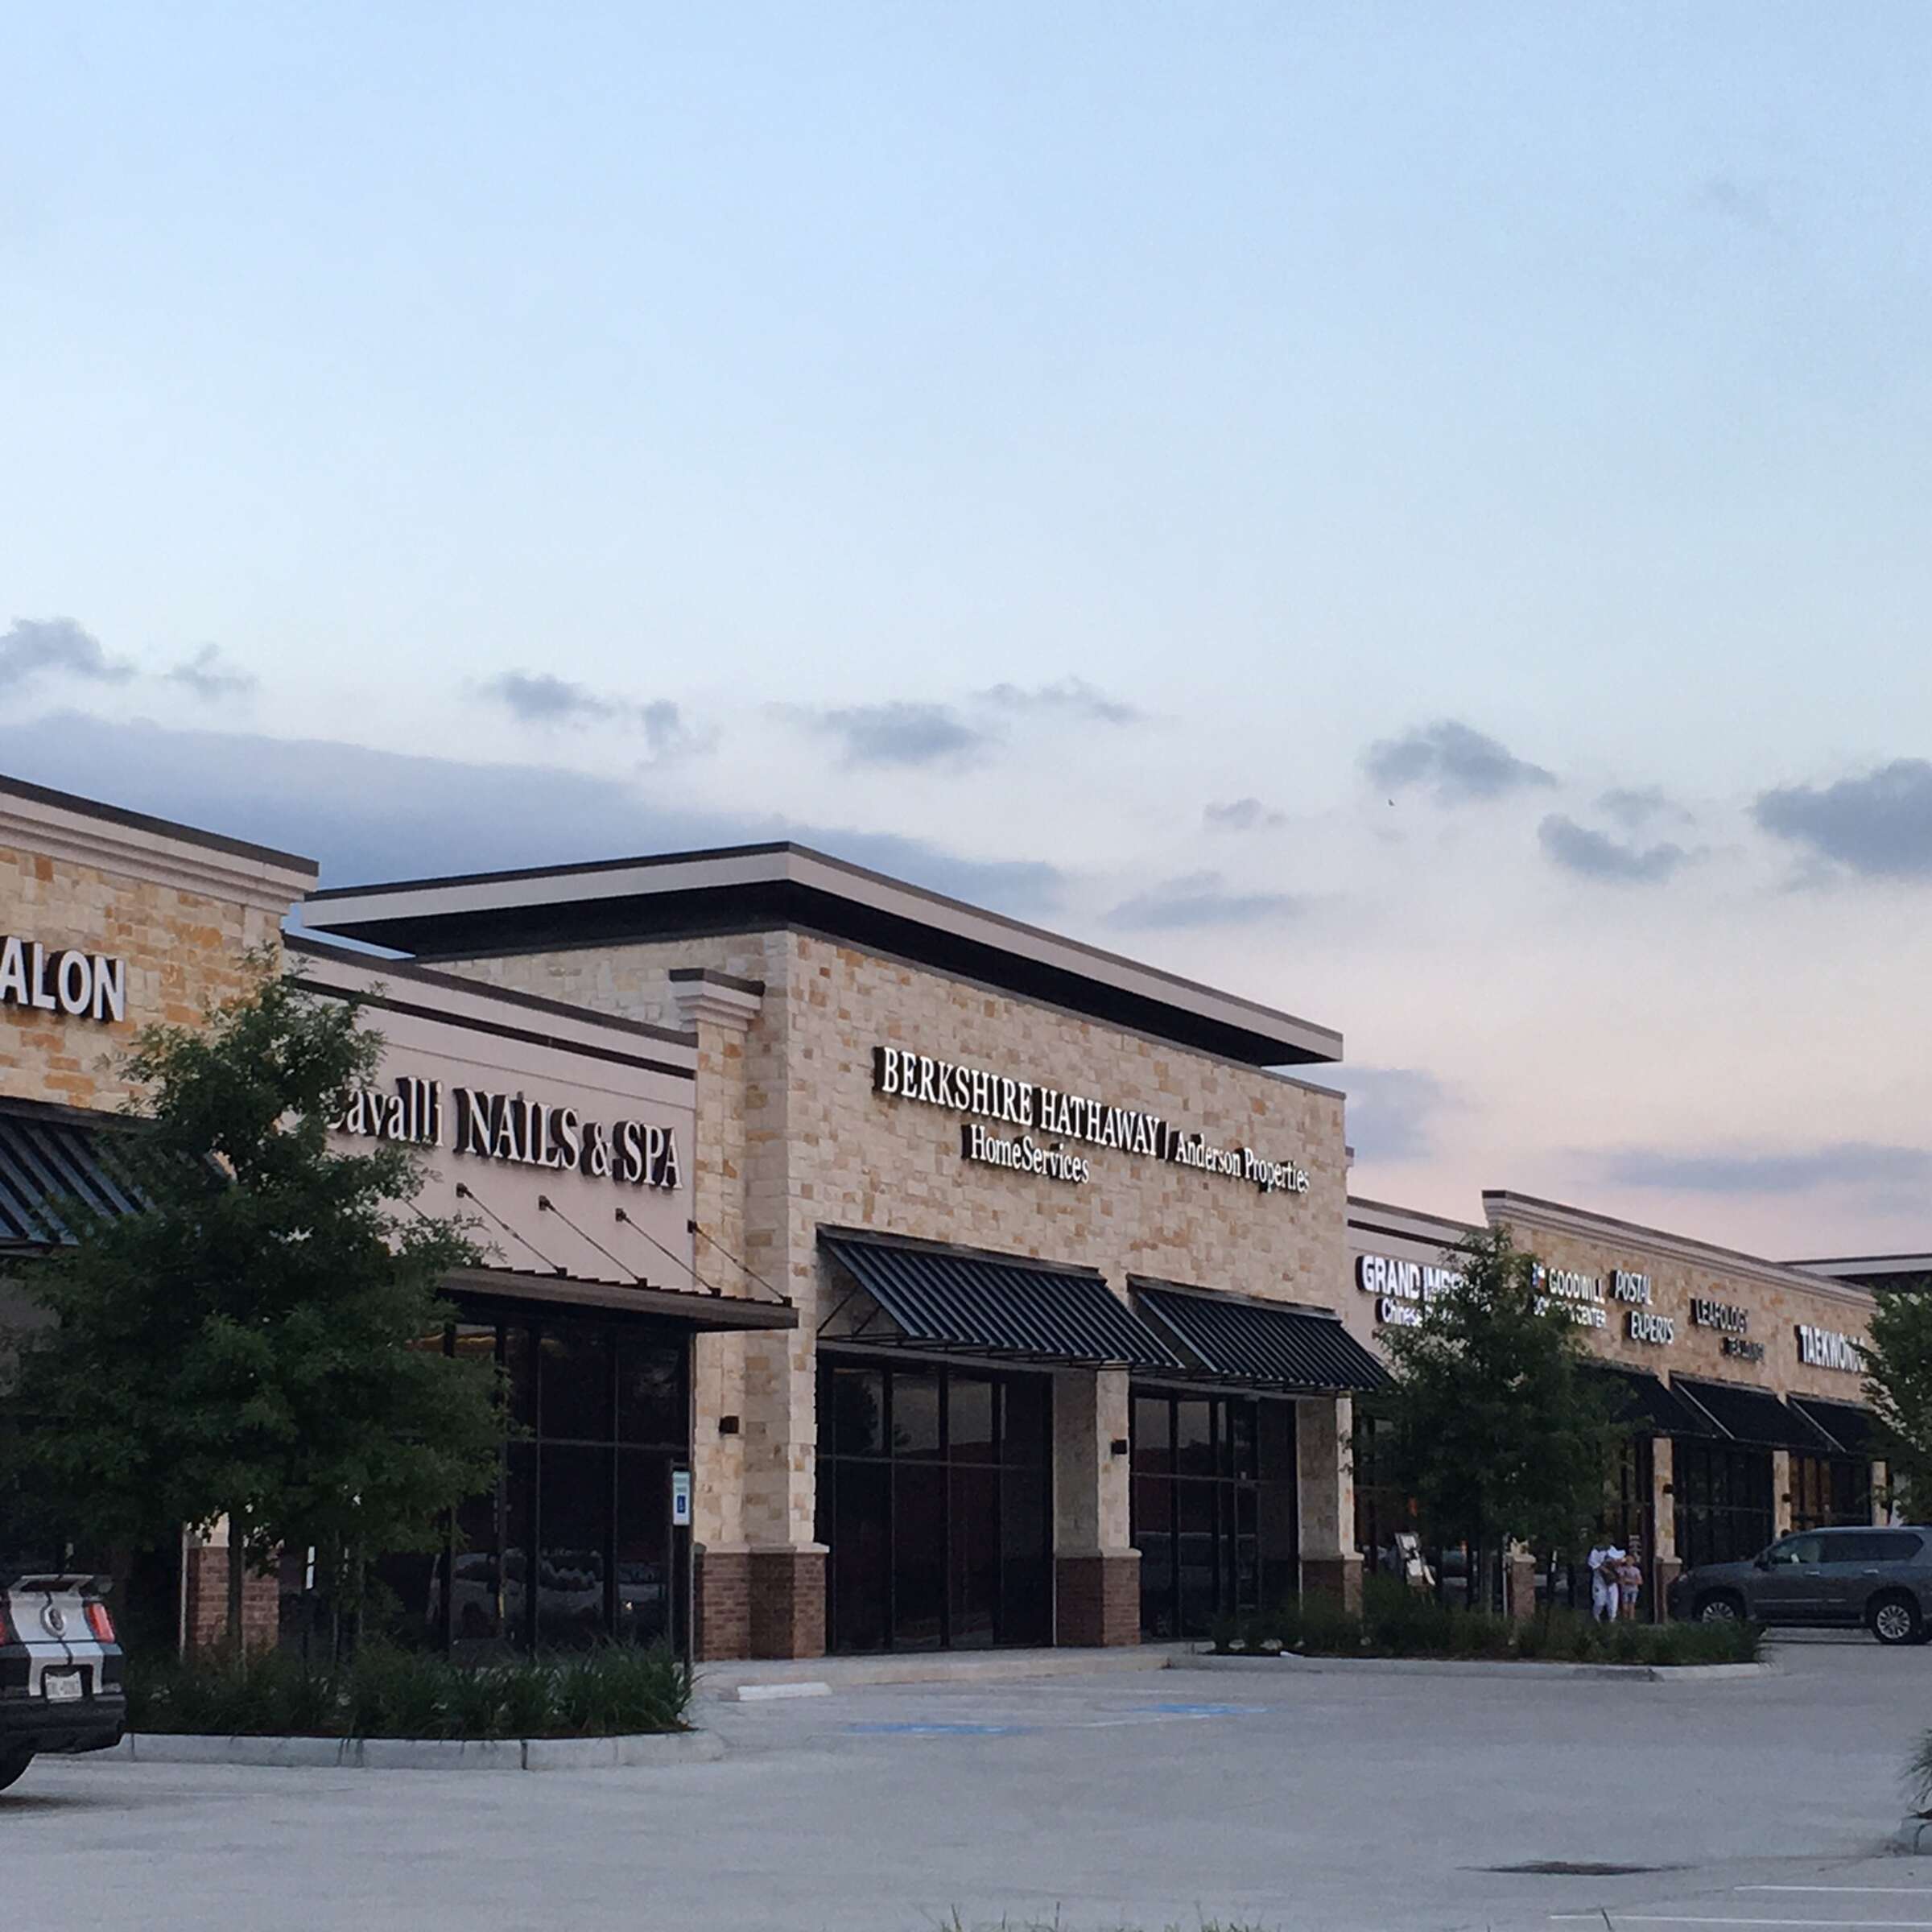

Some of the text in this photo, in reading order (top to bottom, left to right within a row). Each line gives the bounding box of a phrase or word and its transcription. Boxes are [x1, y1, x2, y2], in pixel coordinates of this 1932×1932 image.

[463, 1088, 580, 1170] NAILS
[591, 1121, 612, 1177] &
[621, 1120, 683, 1189] SPA
[881, 1046, 1033, 1125] BERKSHIRE
[1039, 1087, 1160, 1156] HATHAWAY
[1174, 1130, 1241, 1178] Anderson
[1245, 1147, 1310, 1194] Properties
[970, 1124, 1090, 1184] HomeServices
[1361, 1254, 1421, 1300] GRAND
[1549, 1267, 1605, 1304] GOODWILL
[1614, 1269, 1653, 1305] POSTAL
[1631, 1311, 1675, 1344] EXPERTS
